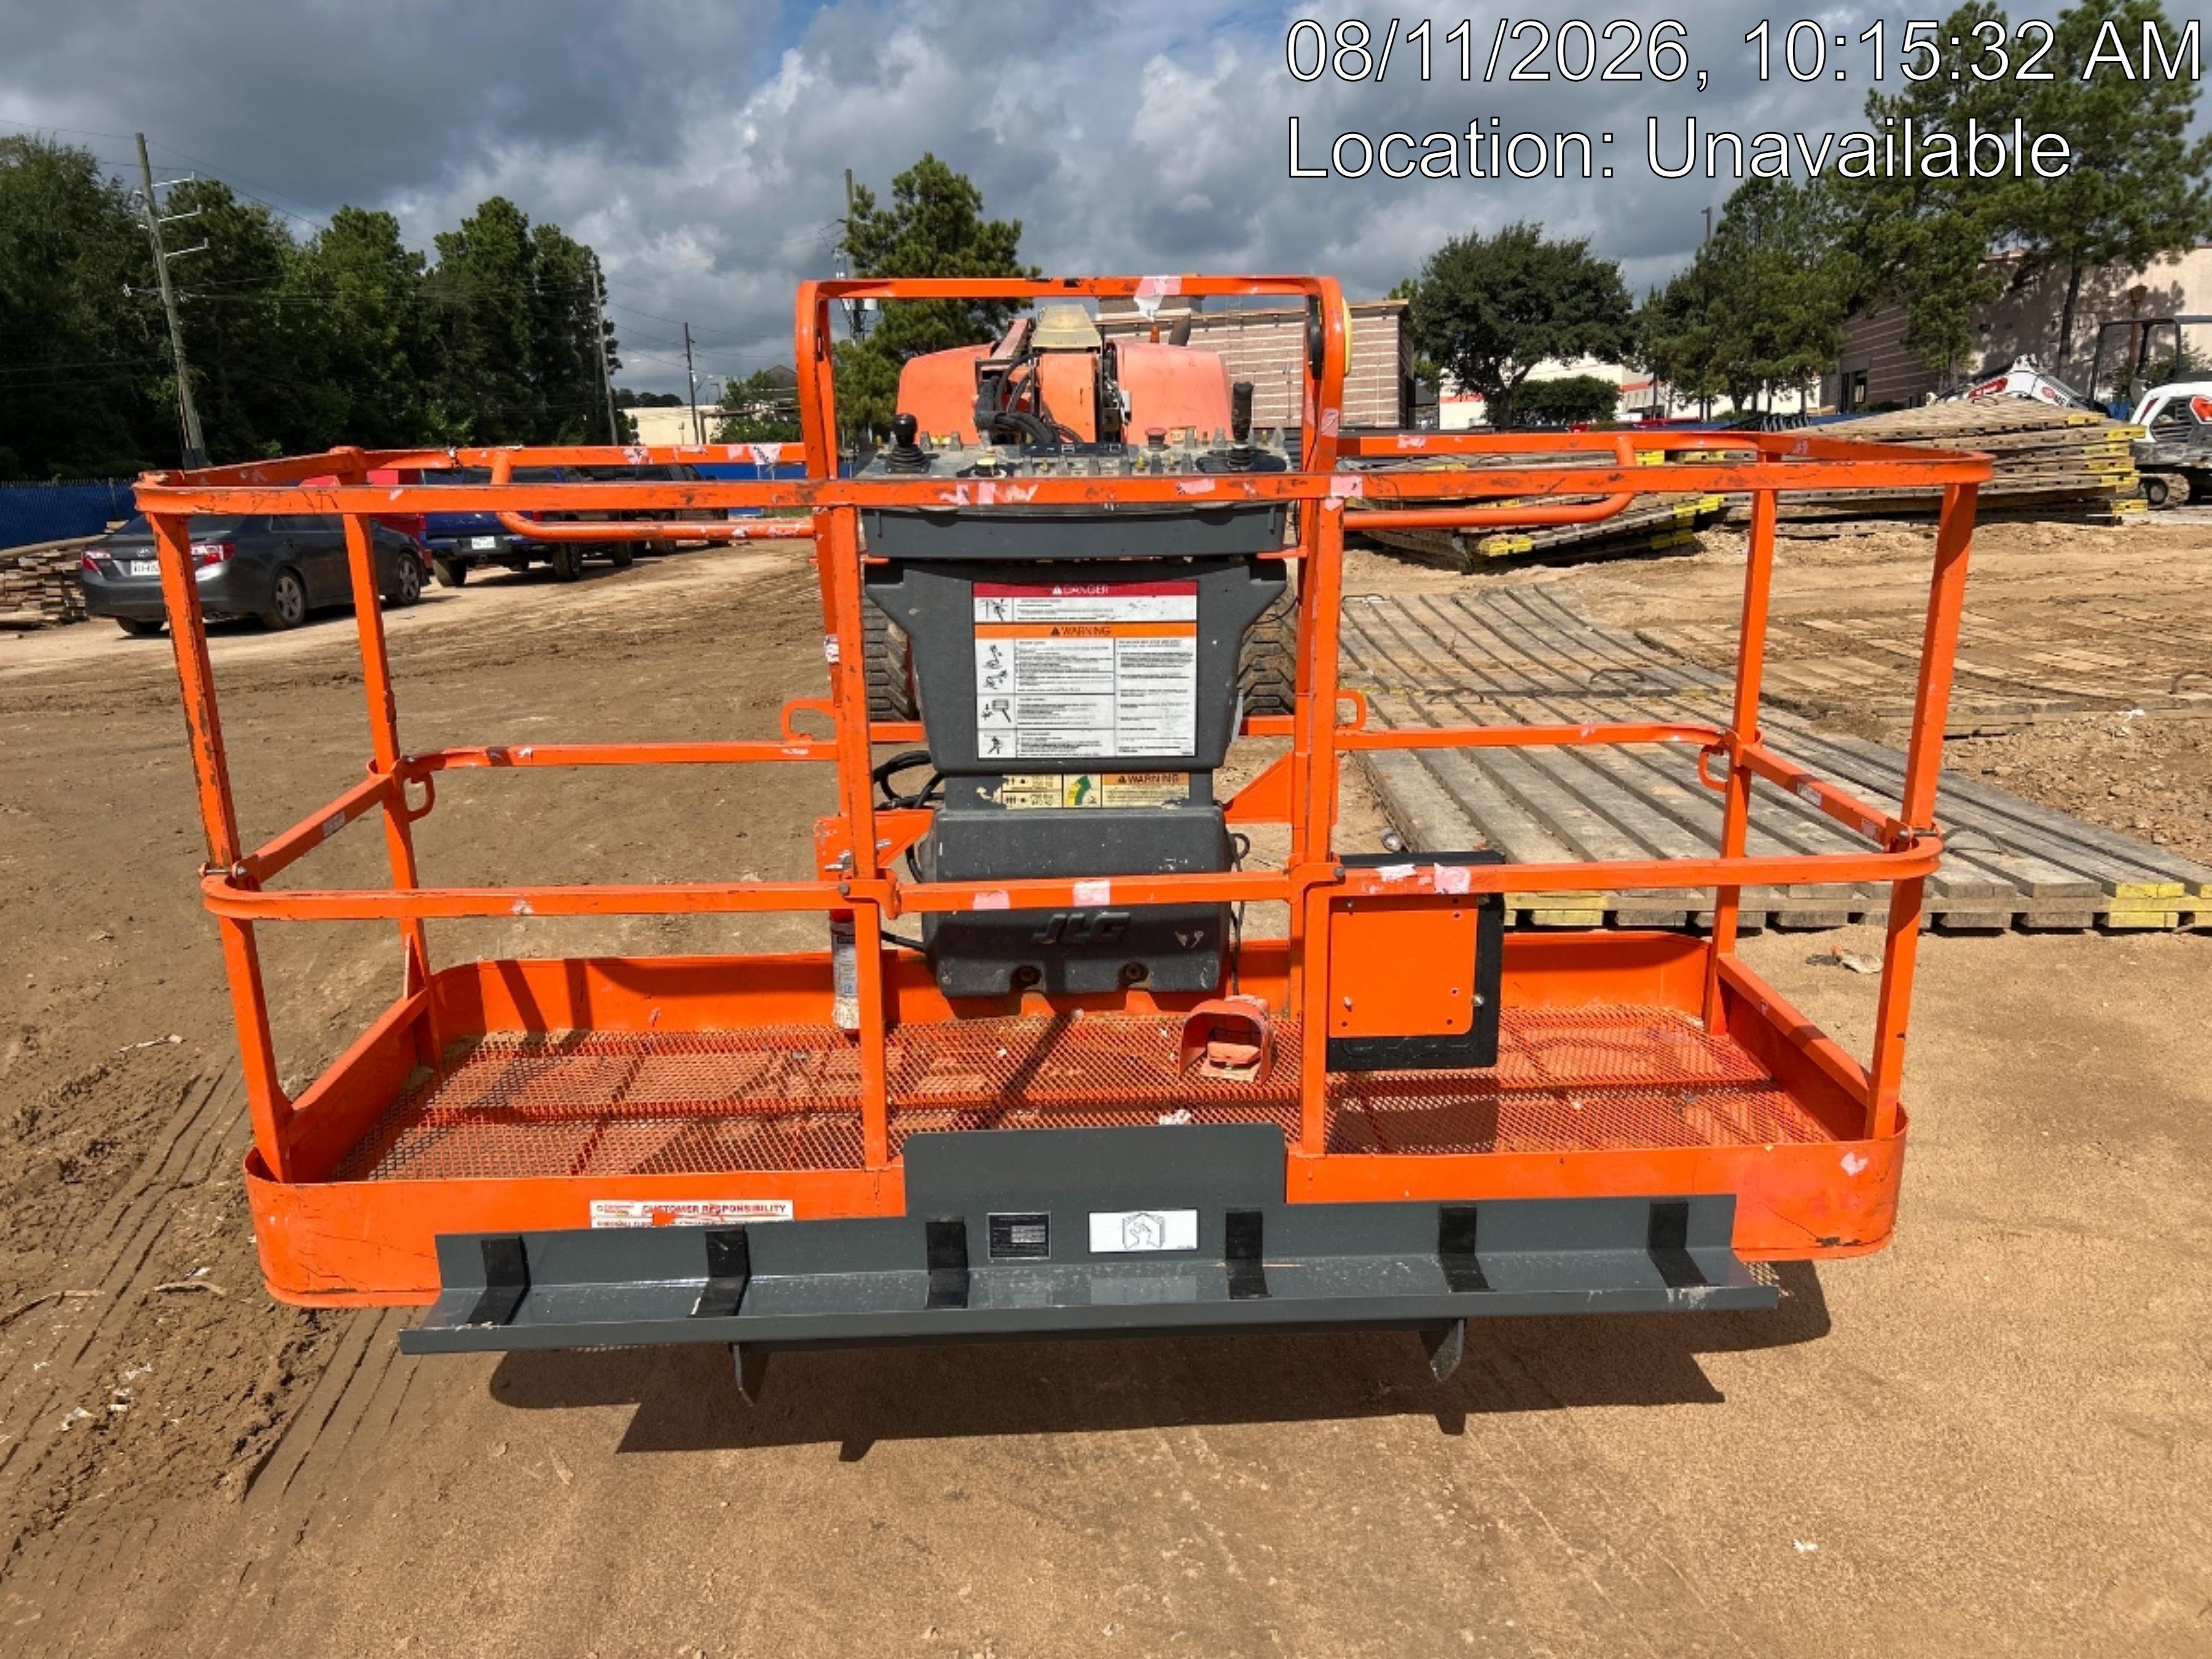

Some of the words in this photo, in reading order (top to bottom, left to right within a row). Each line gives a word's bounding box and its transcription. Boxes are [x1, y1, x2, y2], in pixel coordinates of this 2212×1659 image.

[1063, 584, 1108, 595] DANGER
[1061, 626, 1110, 636] WARNING
[1128, 774, 1179, 784] WARNING
[1032, 912, 1130, 944] JLG
[702, 1204, 786, 1214] RESPONSIBILITY
